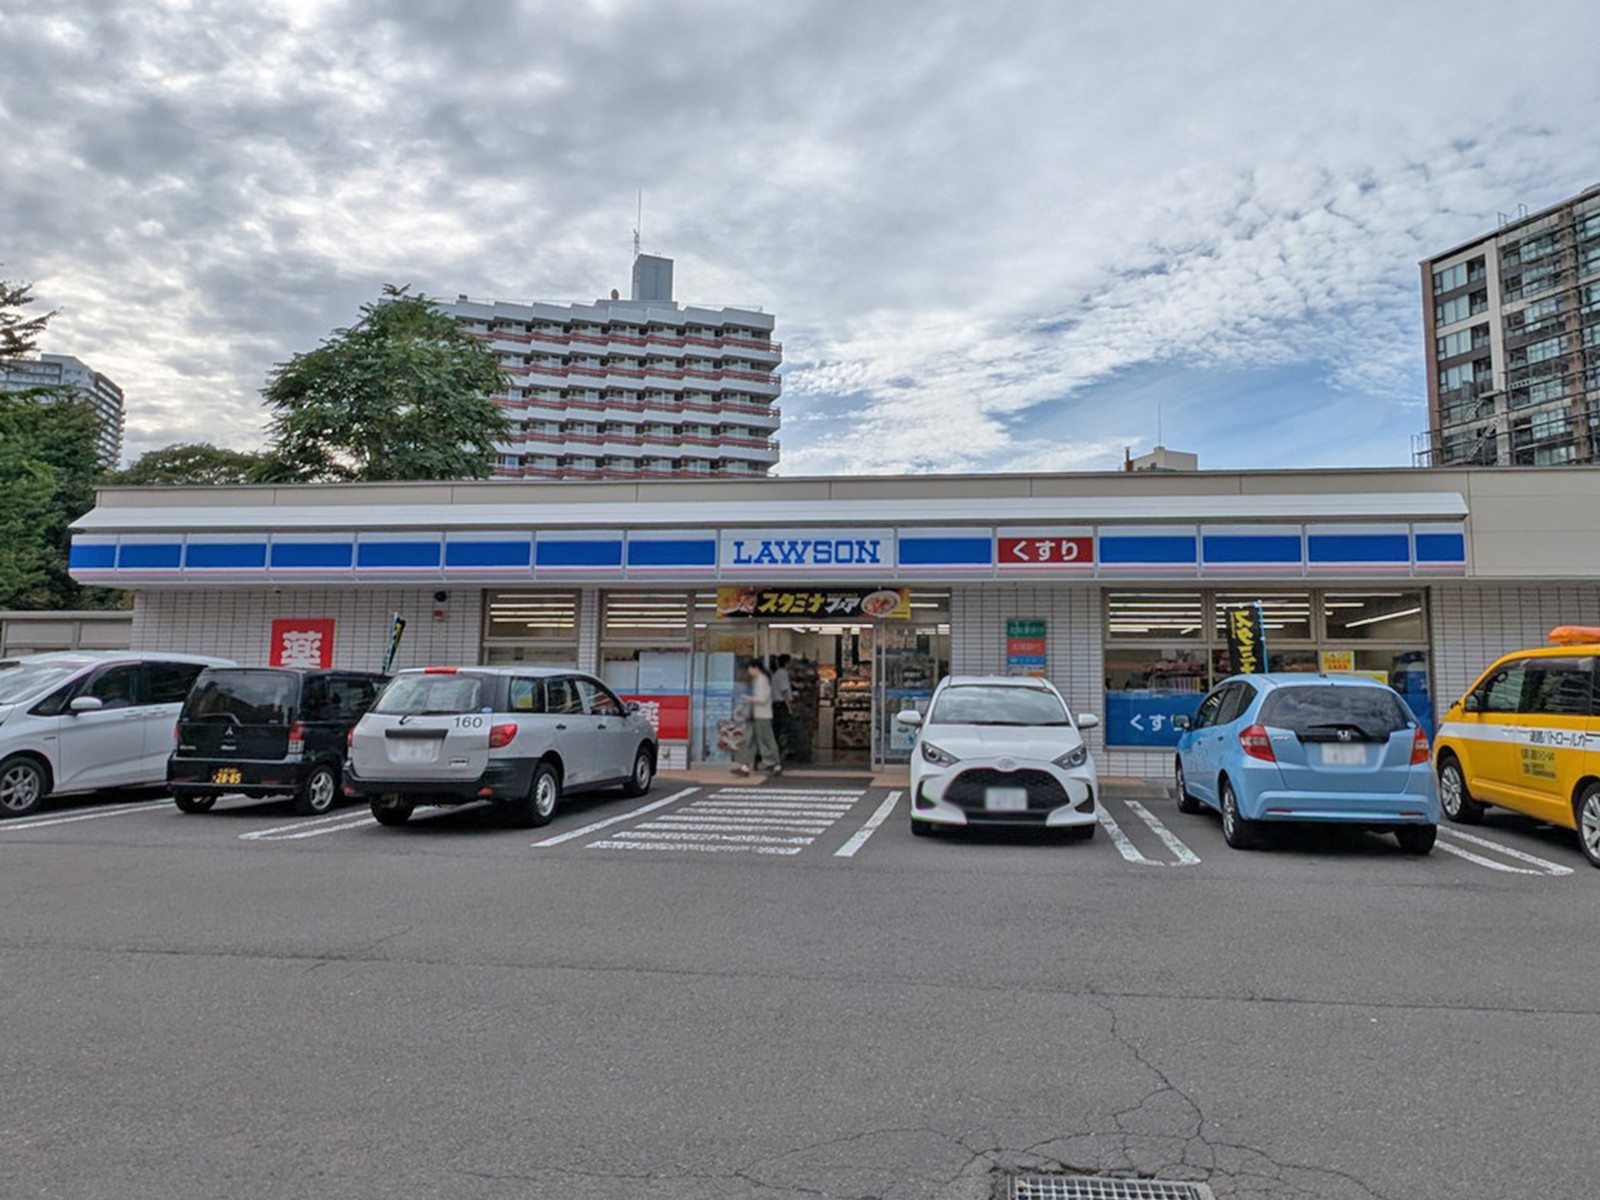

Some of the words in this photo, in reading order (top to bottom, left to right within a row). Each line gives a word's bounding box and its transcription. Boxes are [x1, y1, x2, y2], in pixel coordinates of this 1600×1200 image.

[733, 540, 880, 564] LAWSON
[1012, 540, 1078, 561] くすり
[280, 630, 323, 669] 薬
[455, 717, 483, 728] 160
